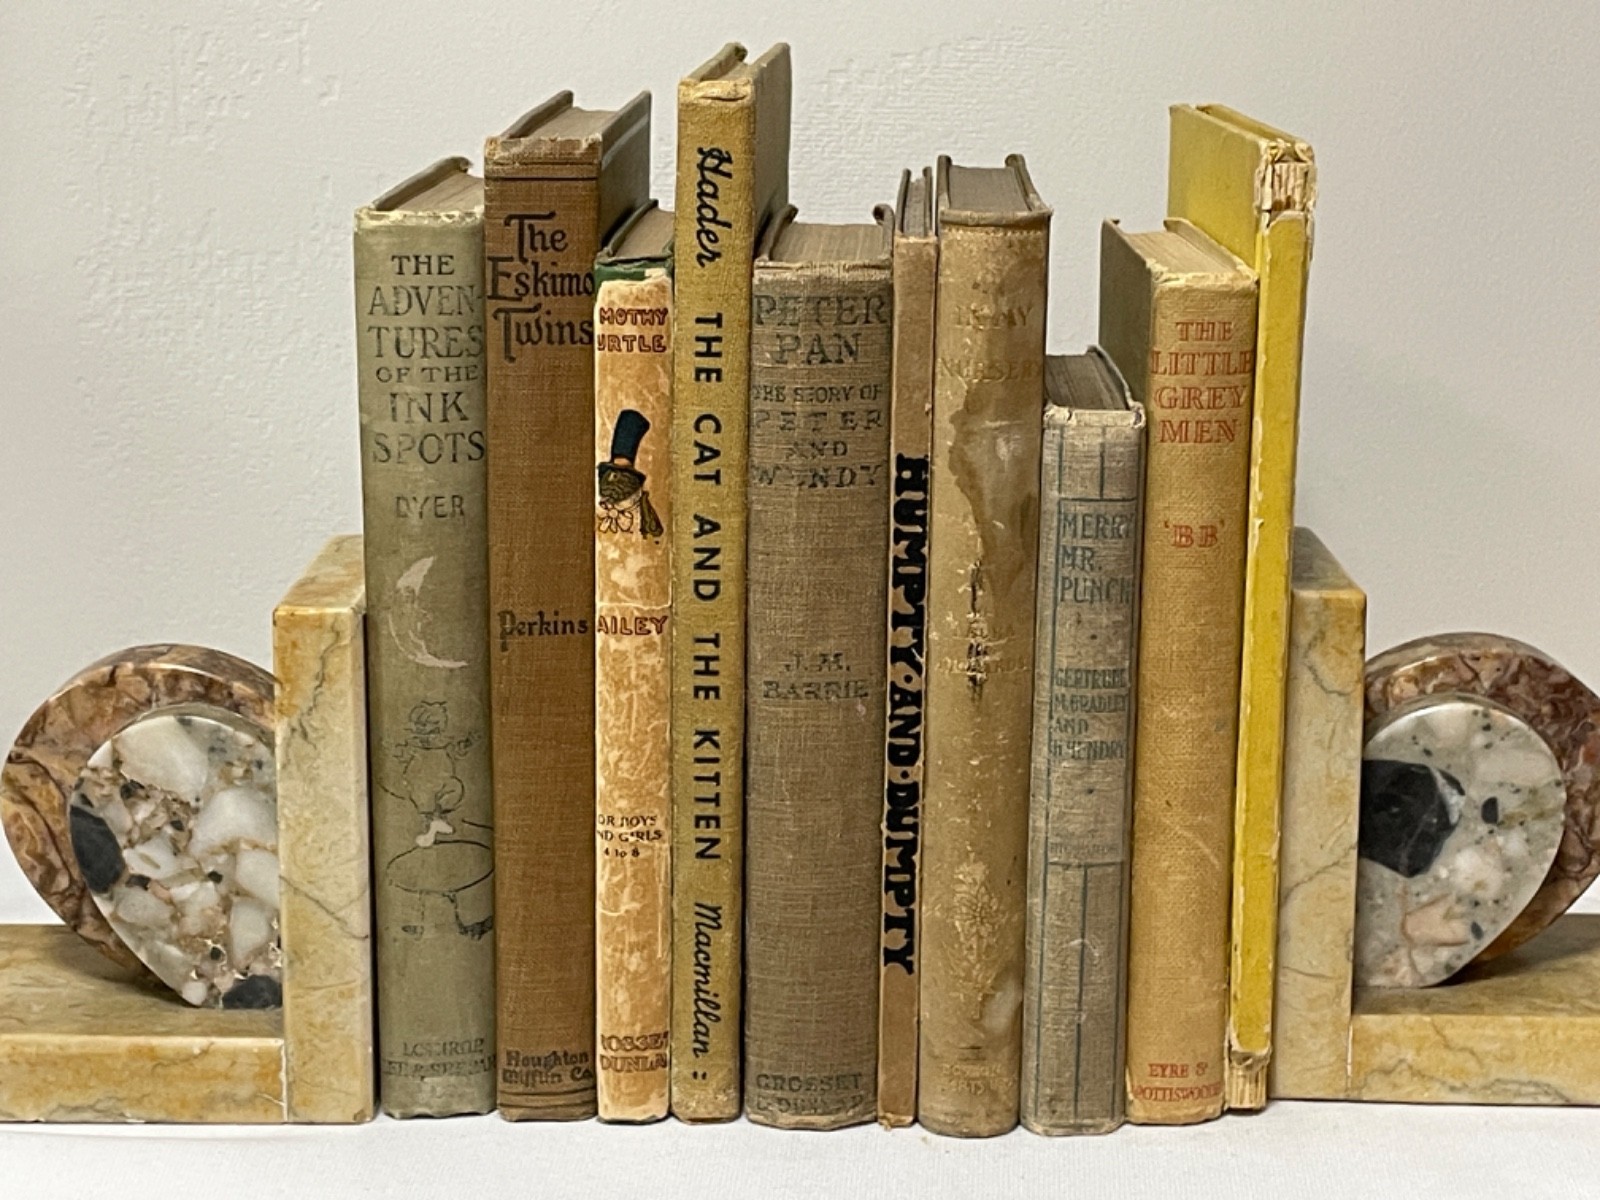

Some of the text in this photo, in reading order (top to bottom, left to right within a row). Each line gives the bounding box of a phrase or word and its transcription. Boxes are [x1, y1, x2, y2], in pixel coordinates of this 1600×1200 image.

[697, 147, 733, 268] Hader
[504, 211, 568, 263] The
[392, 255, 455, 275] THE
[487, 256, 594, 301] Eskimo
[754, 294, 887, 325] PETER
[367, 325, 484, 358] TURES
[492, 303, 595, 363] Twins
[1176, 321, 1234, 342] THE
[776, 333, 862, 365] PAN
[1150, 350, 1254, 376] LITTLE
[376, 365, 479, 383] OF THE
[390, 391, 469, 423] INK
[860, 384, 883, 401] OF
[1154, 385, 1248, 410] GREY
[372, 430, 485, 464] SPOTS
[1158, 418, 1238, 444] MEN
[751, 465, 883, 488] WNDY
[693, 312, 723, 861] THE CAT AND THE KITTEN
[497, 610, 588, 653] Perkins
[883, 453, 929, 975] HUMPTY AND DUMPTY
[693, 902, 722, 1059] Macmillan
[506, 1050, 589, 1072] Houghton
[1148, 1063, 1190, 1078] EYRE
